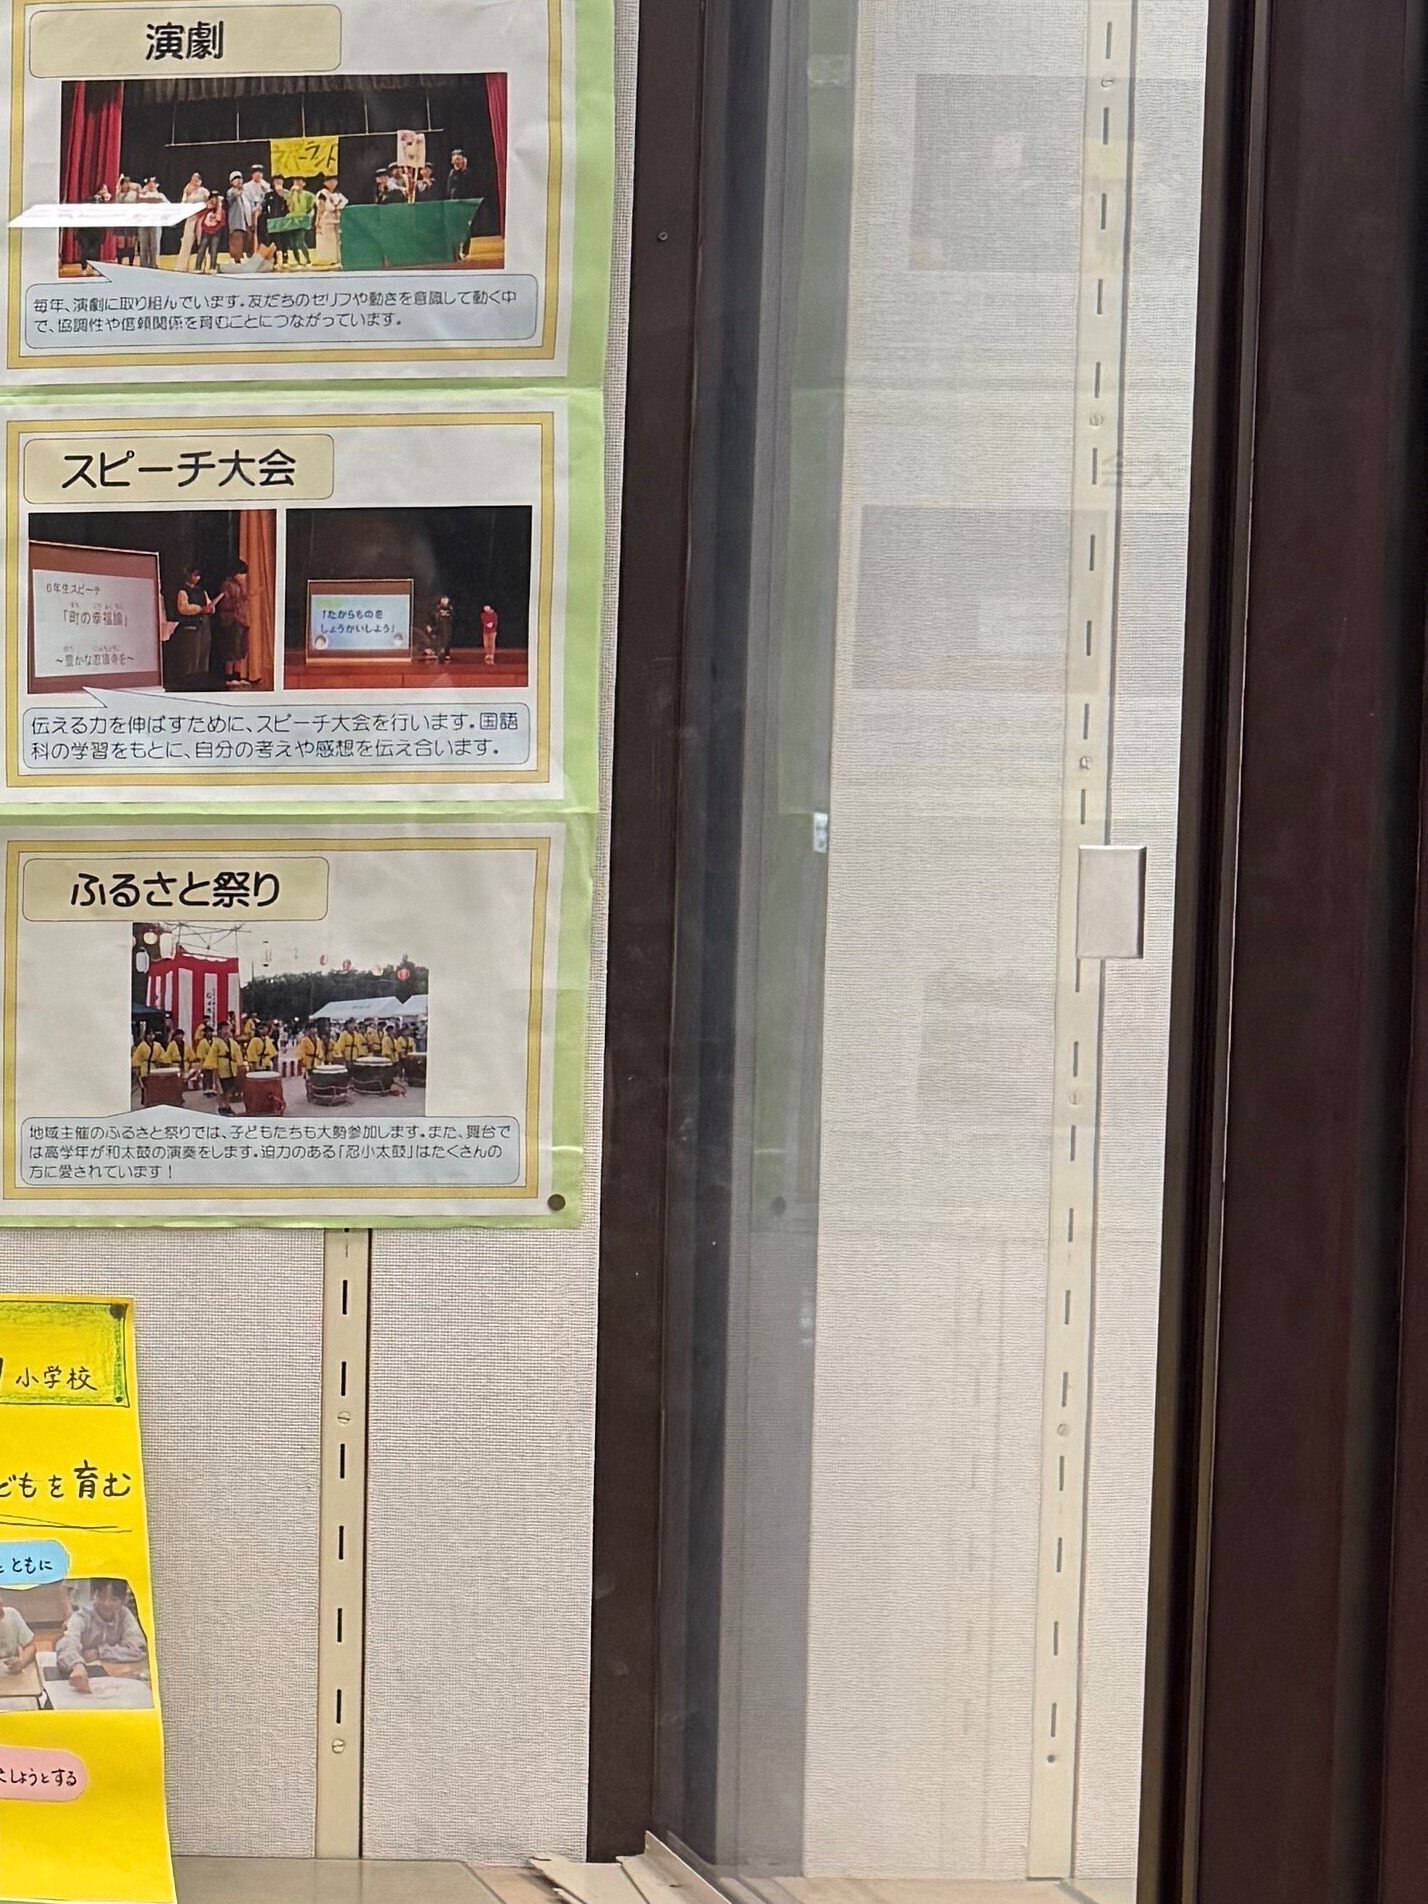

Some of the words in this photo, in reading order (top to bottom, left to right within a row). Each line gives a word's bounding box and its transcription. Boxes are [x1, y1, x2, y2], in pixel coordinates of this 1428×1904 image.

[145, 20, 225, 61] 演劇
[61, 448, 297, 489] スピーチ大会
[31, 711, 519, 736] 伝える力を伸ばすために、スピーチ大会を行います。国語
[31, 738, 500, 762] 科の学習をもとに、自分の考えや感想を伝え合います。
[71, 870, 280, 908] ふるさと祭り
